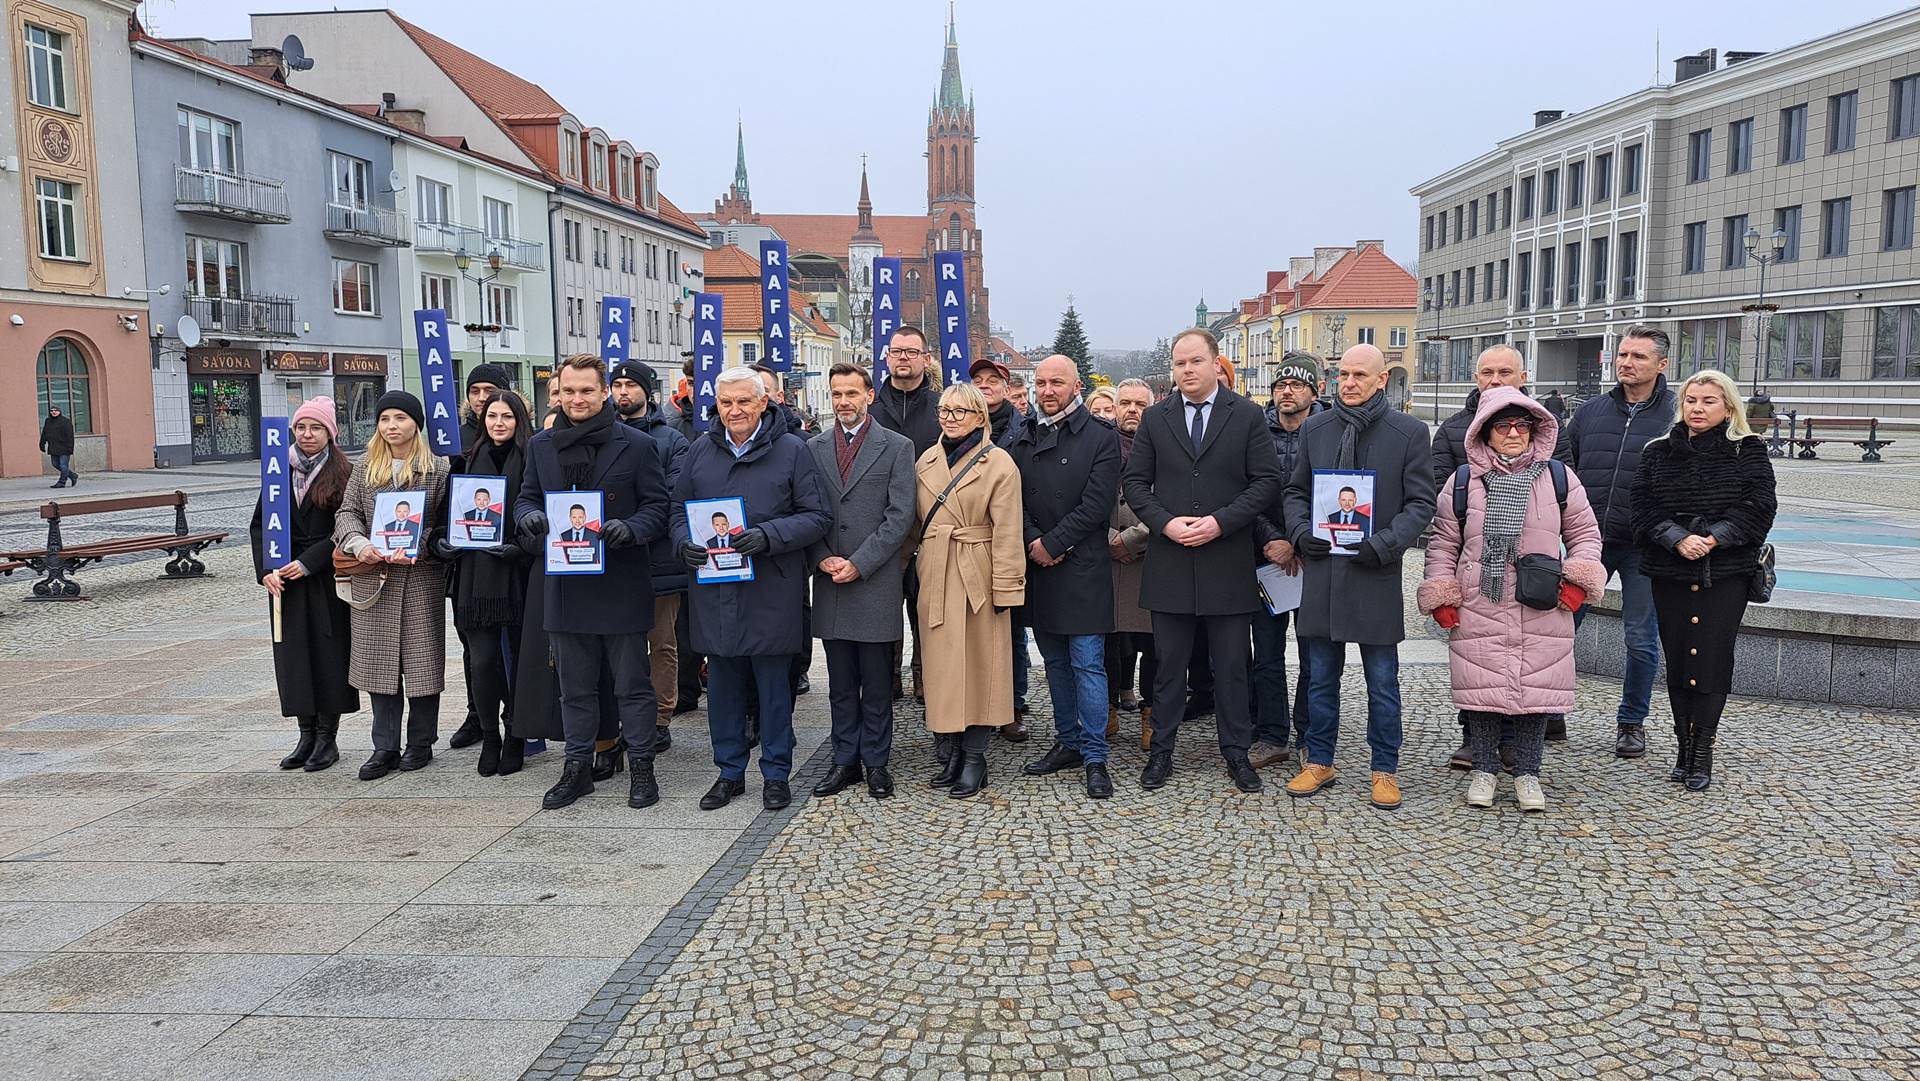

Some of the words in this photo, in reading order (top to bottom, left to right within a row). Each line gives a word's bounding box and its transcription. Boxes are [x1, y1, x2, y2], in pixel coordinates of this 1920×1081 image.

[607, 307, 623, 373] RAF
[767, 250, 783, 362] RAFAŁ
[942, 263, 963, 385] RAFAŁ
[202, 356, 251, 369] SAVONA
[344, 360, 380, 371] SAVONA
[423, 321, 451, 445] RAFAŁ
[266, 428, 282, 558] RAFAŁ
